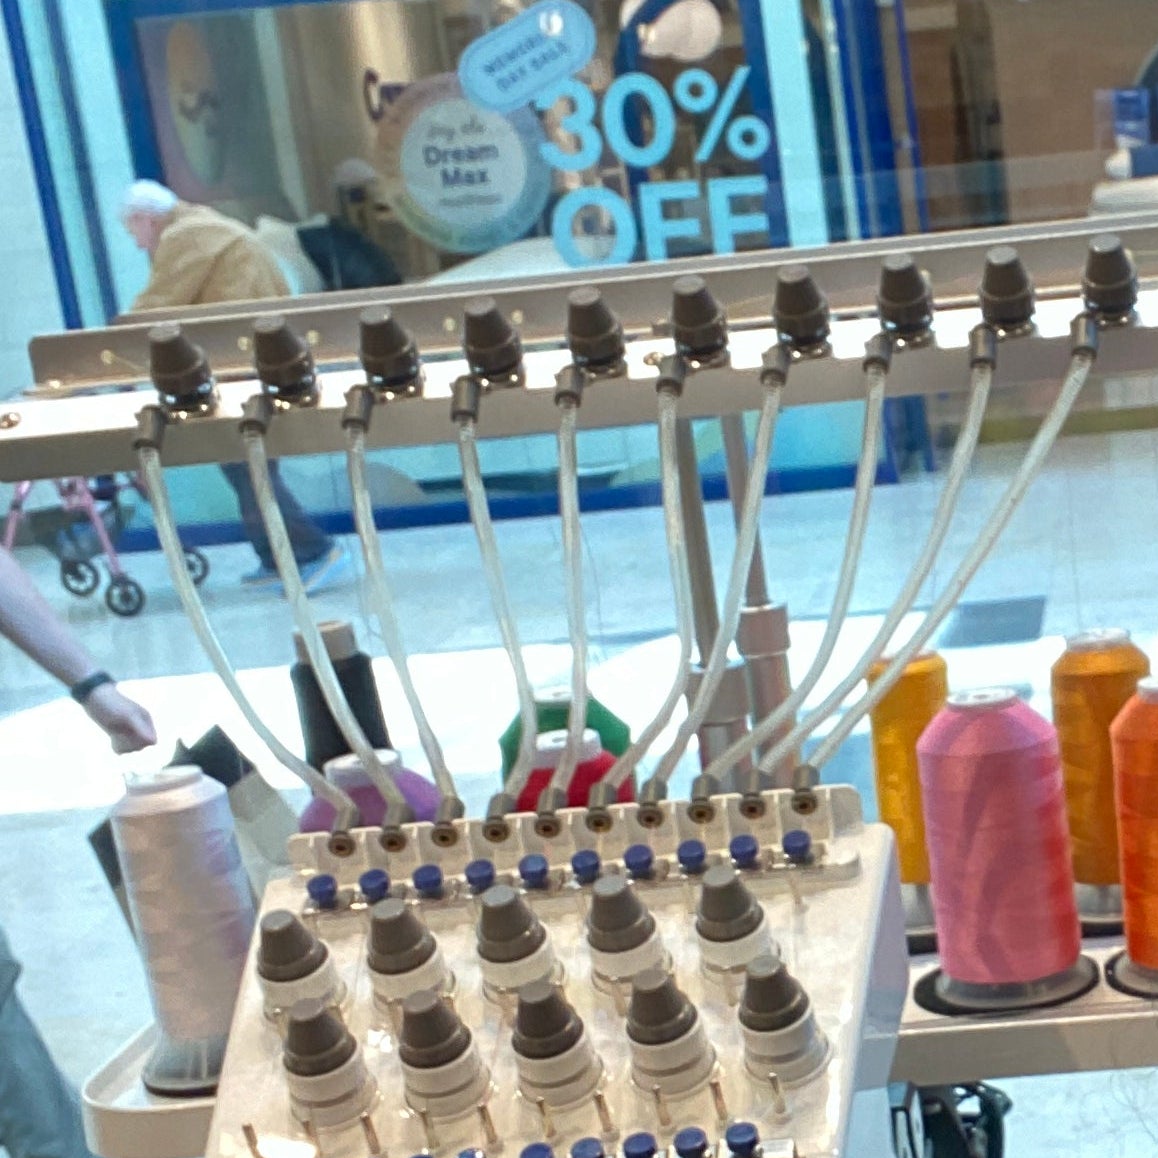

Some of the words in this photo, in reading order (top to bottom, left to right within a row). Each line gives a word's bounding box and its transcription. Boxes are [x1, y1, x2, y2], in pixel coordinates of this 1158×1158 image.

[423, 144, 500, 168] Dream
[538, 65, 771, 172] 30%
[552, 175, 770, 269] OFF
